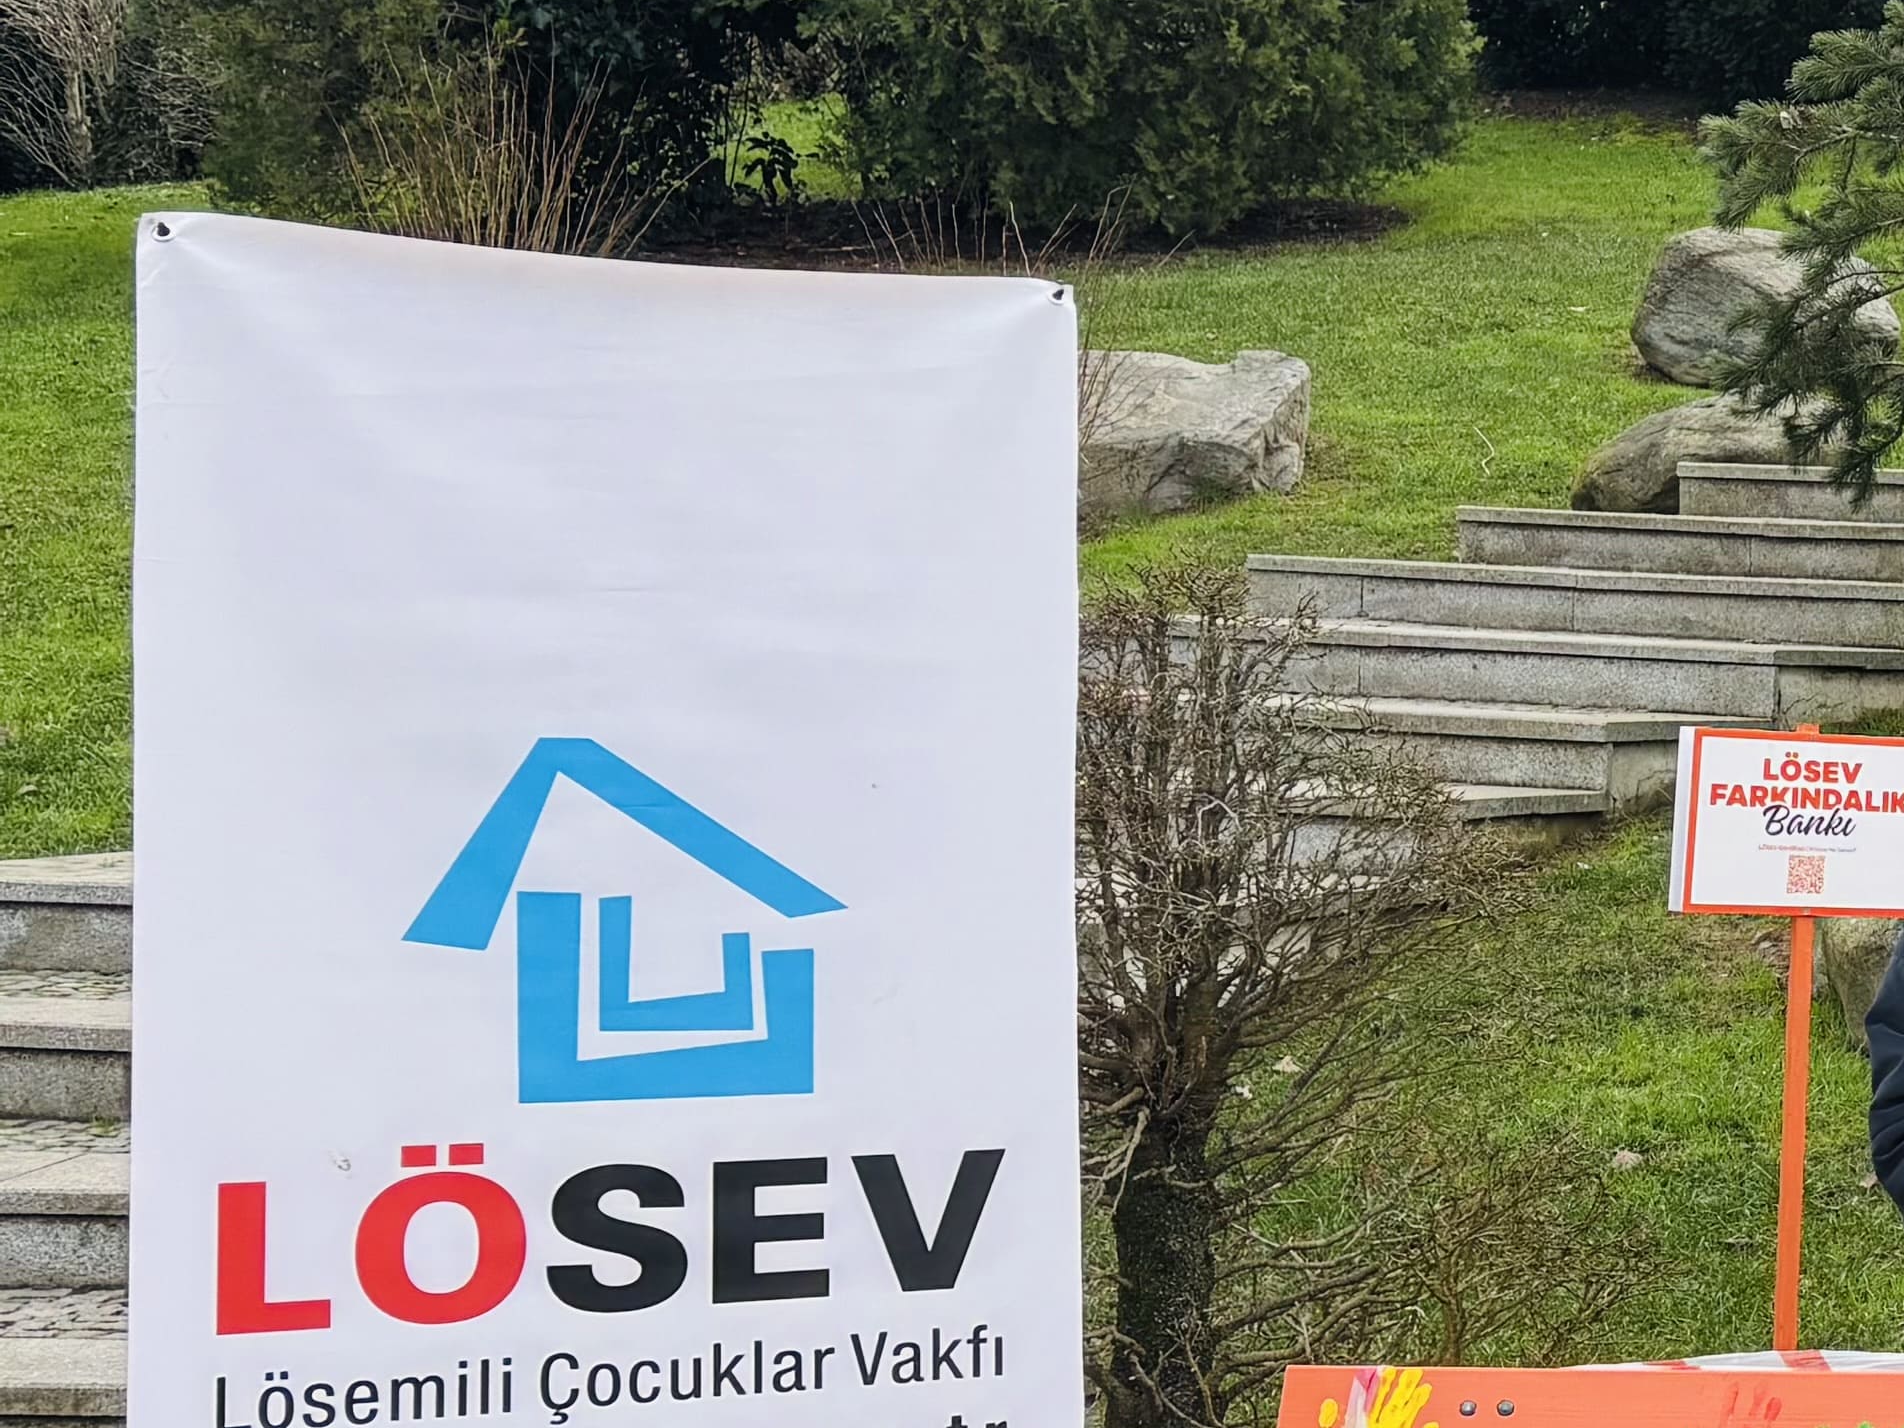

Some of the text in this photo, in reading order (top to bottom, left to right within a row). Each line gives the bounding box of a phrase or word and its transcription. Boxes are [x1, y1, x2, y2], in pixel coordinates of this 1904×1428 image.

[1763, 752, 1862, 784] LÖSEV
[1763, 804, 1856, 837] Bankı
[215, 1143, 1005, 1336] LÖSEV
[538, 1343, 835, 1426] Çocuklar
[852, 1324, 1006, 1390] Vakfı
